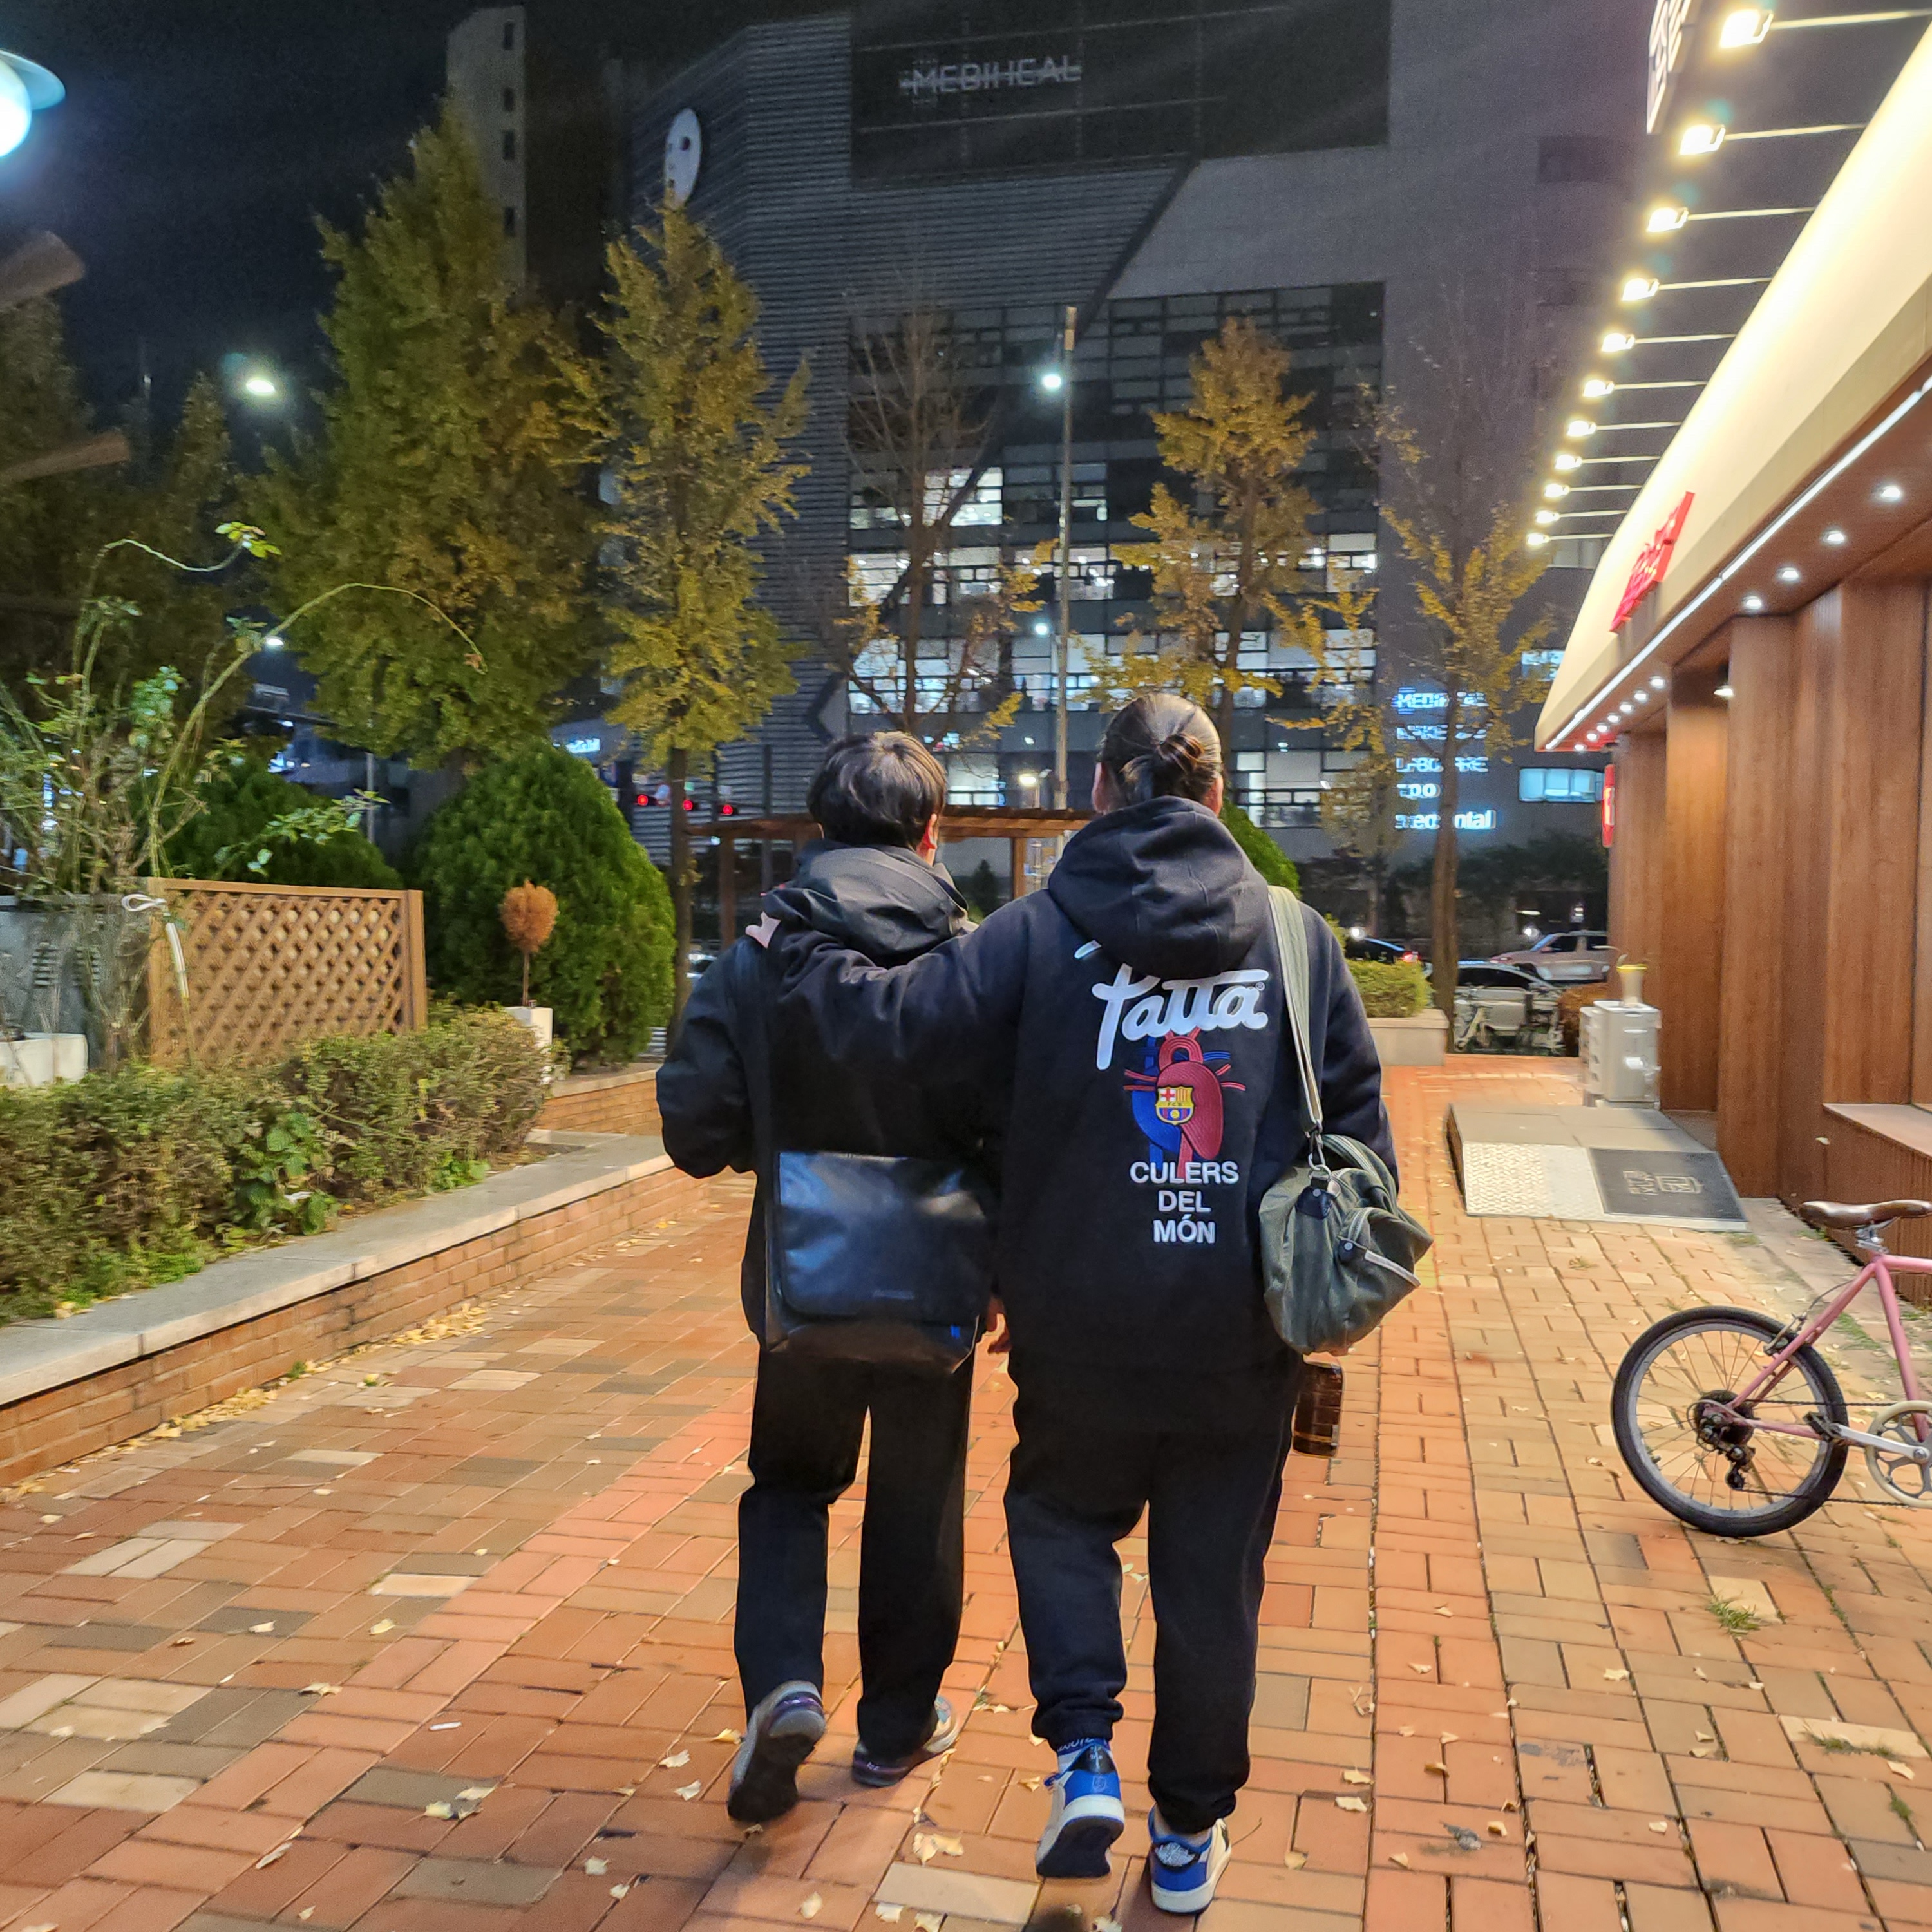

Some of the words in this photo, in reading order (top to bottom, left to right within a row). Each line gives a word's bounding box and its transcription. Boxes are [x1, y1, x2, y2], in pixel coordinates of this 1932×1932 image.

[1130, 1161, 1239, 1184] CULERS
[1158, 1190, 1211, 1213] DEL
[1153, 1214, 1215, 1244] MÓN
